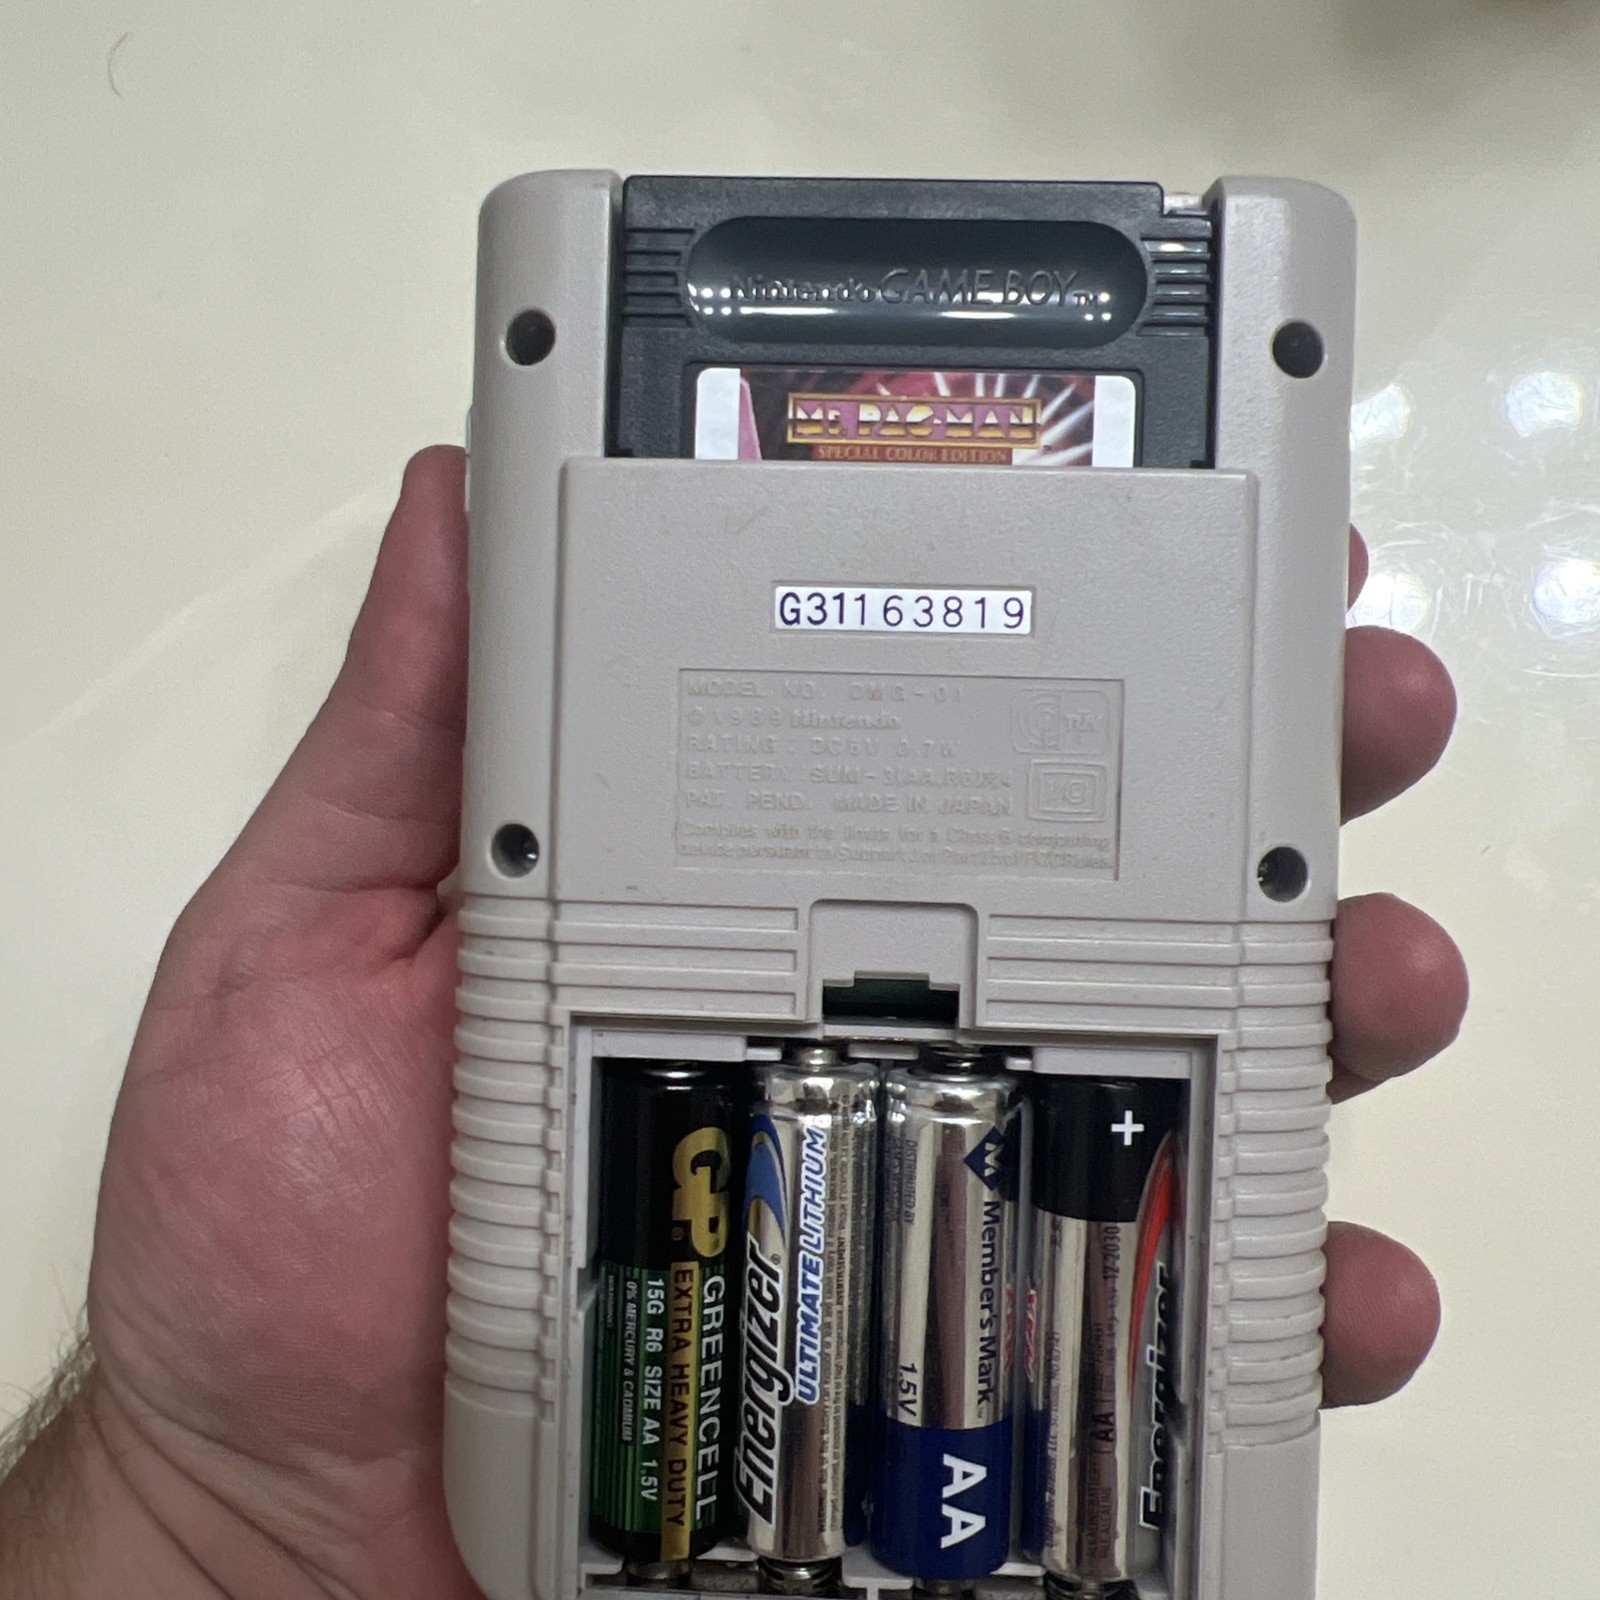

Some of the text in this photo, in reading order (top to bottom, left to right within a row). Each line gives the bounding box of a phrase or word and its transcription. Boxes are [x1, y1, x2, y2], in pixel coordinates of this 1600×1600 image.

[732, 274, 876, 302] Nintendo
[879, 268, 995, 305] GAME
[1002, 269, 1079, 307] BOY
[779, 591, 1025, 630] G31163819
[688, 676, 768, 699] MODEL
[789, 708, 902, 731] Nintendo
[672, 1126, 733, 1258] GP
[799, 1126, 827, 1253] LITHIUM
[979, 1200, 999, 1327] Member's
[623, 1301, 638, 1367] MERCURY
[796, 1252, 824, 1404] ULTIMATE
[621, 1380, 635, 1442] CADMIUM
[639, 1277, 665, 1502] 15G R6 SIZE AA 1.5V
[666, 1268, 695, 1527] EXTRA HEAVY DUTY
[695, 1274, 726, 1521] GREENCELL
[735, 1232, 795, 1526] Energizer
[899, 1362, 918, 1417] 1.5V
[1089, 1411, 1115, 1443] AA
[940, 1452, 988, 1550] AA
